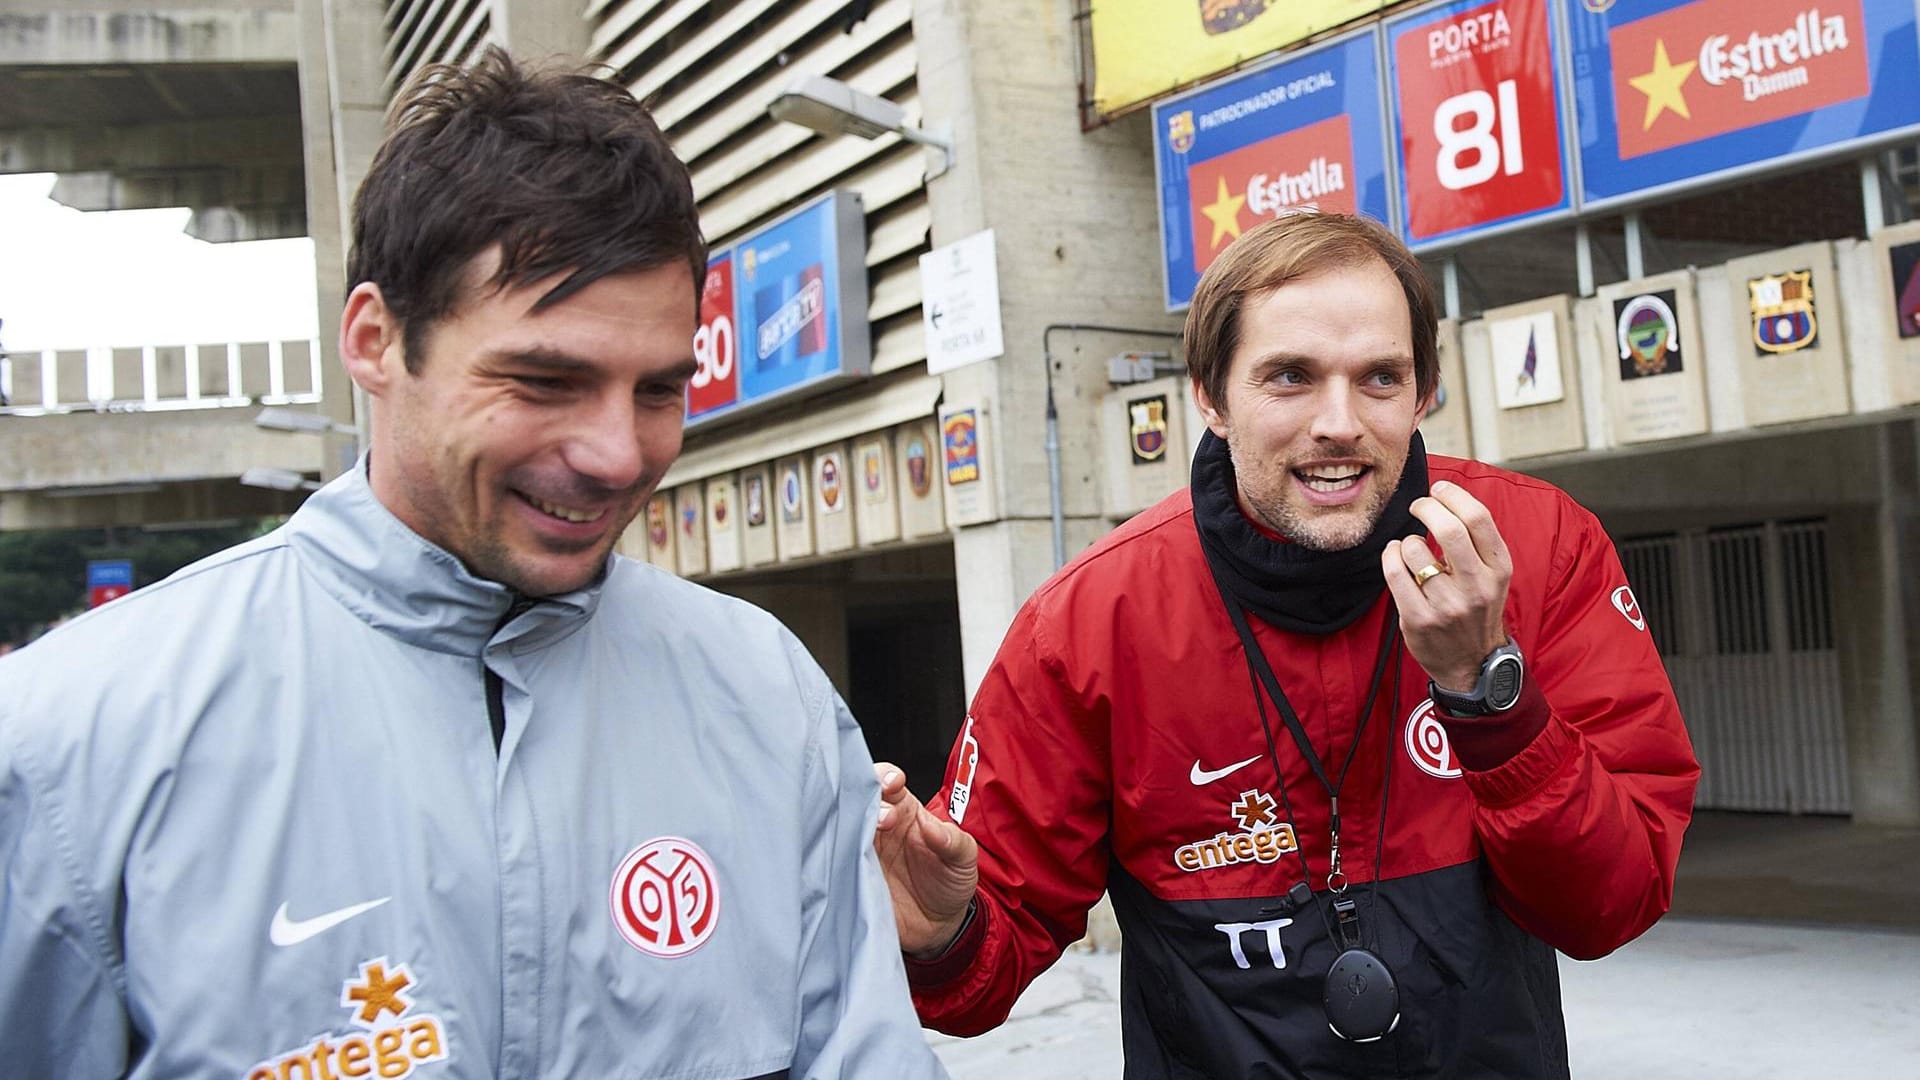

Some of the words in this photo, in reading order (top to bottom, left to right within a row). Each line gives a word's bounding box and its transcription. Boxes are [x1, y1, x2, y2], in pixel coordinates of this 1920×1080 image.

[1427, 8, 1512, 59] PORTA
[1699, 8, 1849, 86] Estrella
[1199, 86, 1287, 132] PATROCINADOR
[1433, 79, 1524, 191] 81
[1247, 157, 1345, 216] Estrella
[691, 315, 734, 388] 80
[1177, 825, 1298, 870] entega
[1214, 918, 1294, 970] TT
[250, 1019, 441, 1080] ntega
